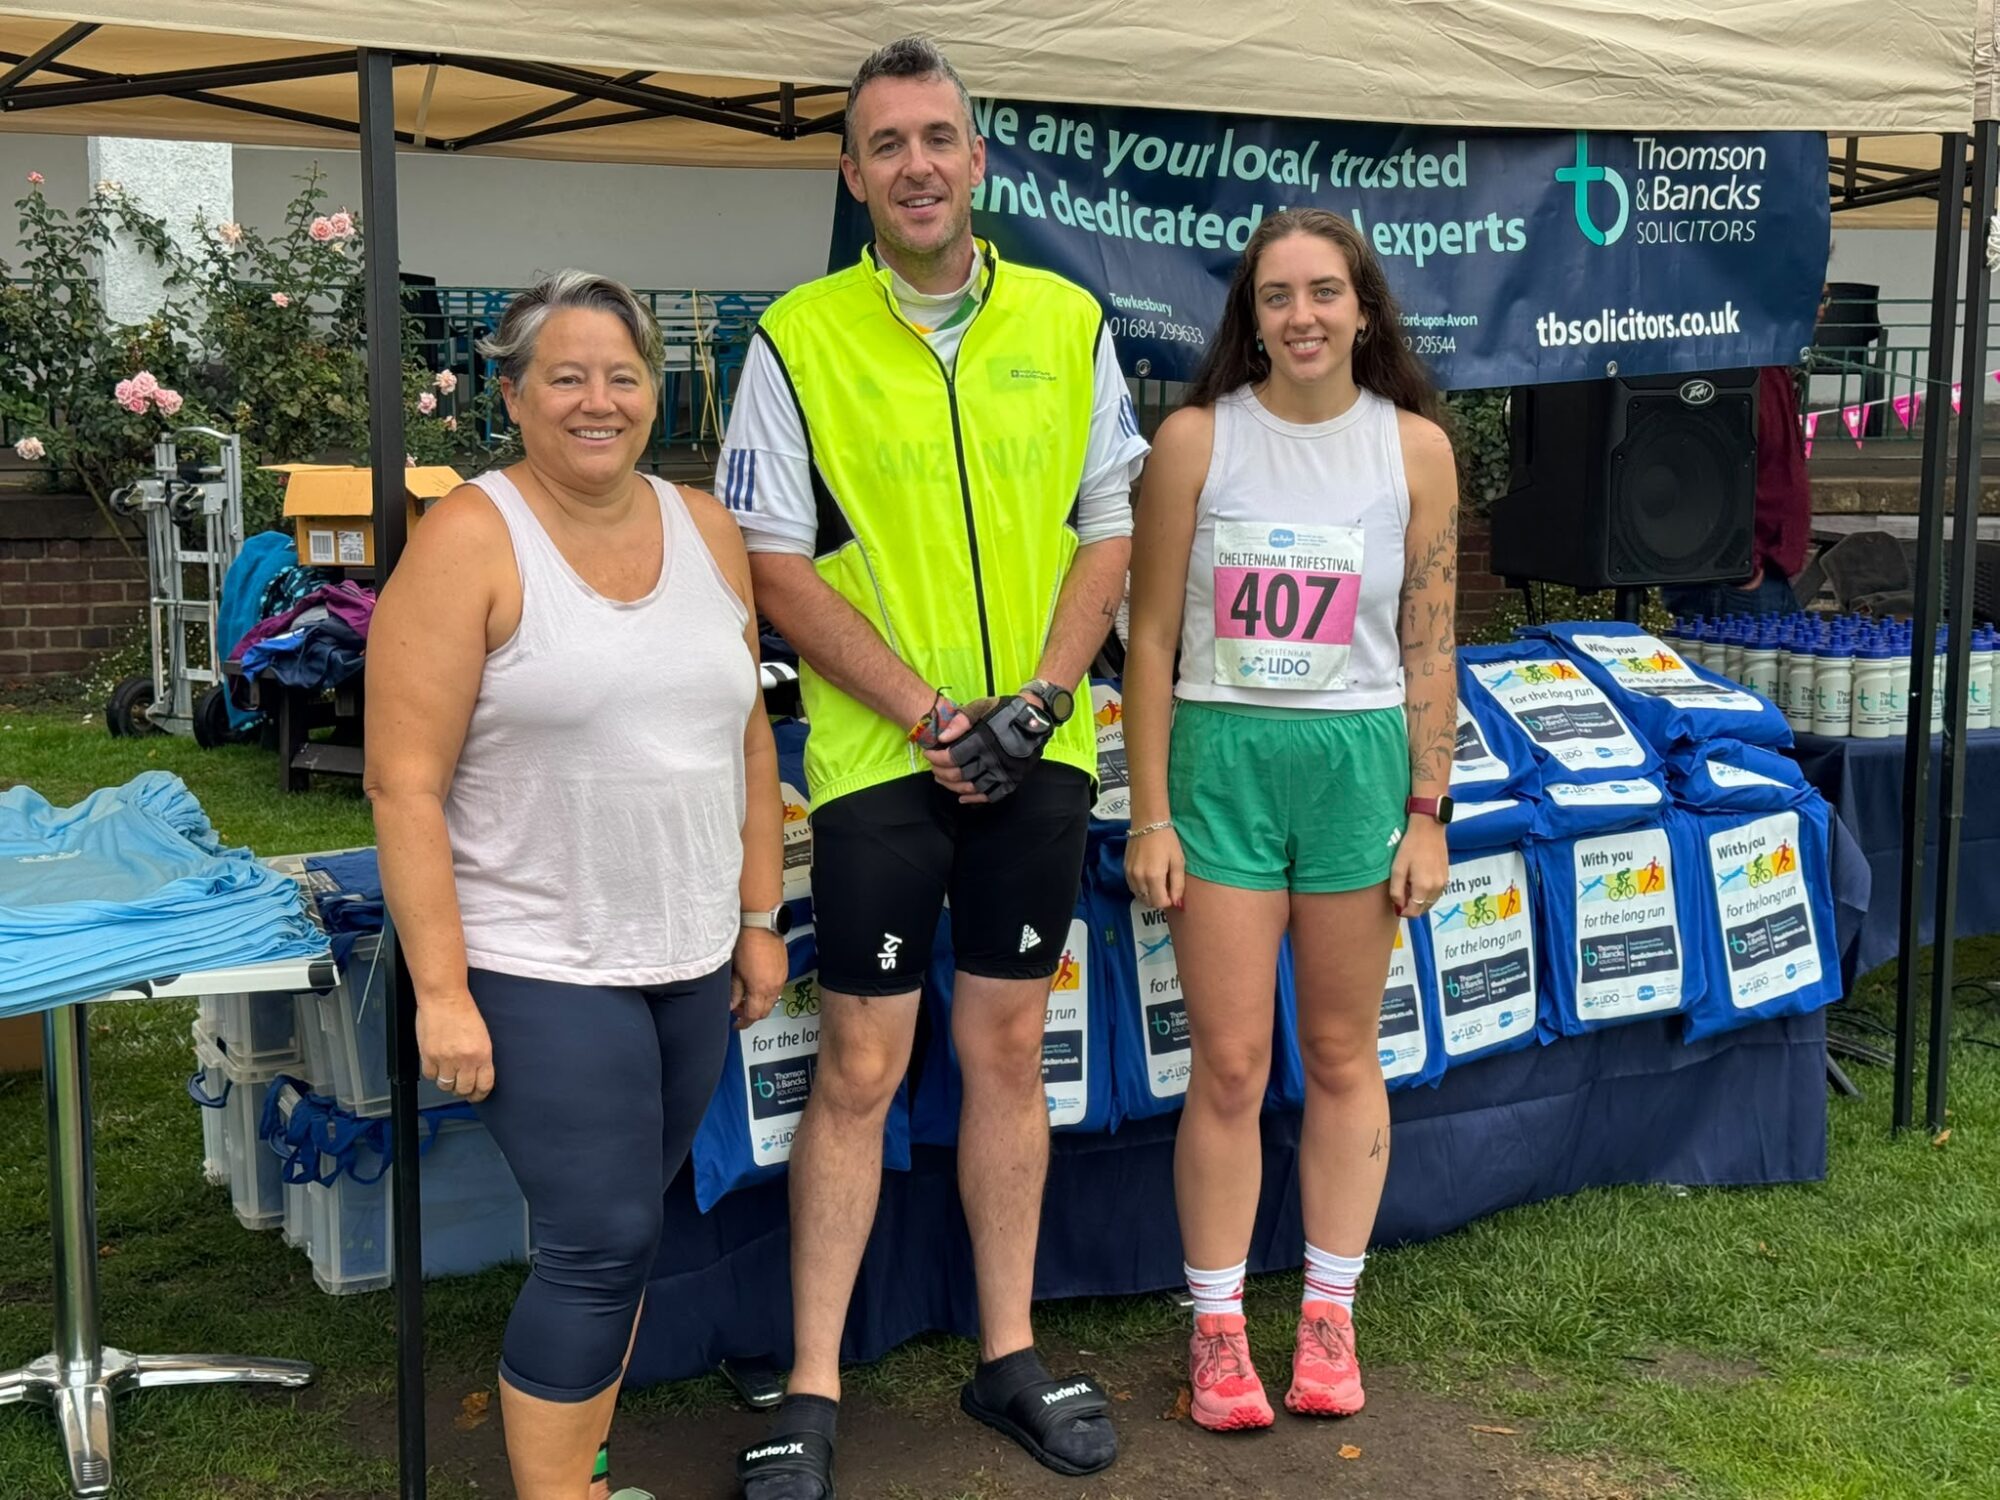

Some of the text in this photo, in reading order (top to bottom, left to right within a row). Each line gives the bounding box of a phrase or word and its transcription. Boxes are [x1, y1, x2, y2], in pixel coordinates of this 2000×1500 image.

[1028, 114, 1095, 161] are
[1103, 129, 1215, 178] your
[1218, 128, 1320, 193] local,
[1330, 140, 1467, 188] trusted
[1633, 137, 1766, 171] Thomson
[1050, 179, 1264, 252] dedicated
[1373, 212, 1527, 268] experts
[1637, 219, 1757, 244] SOLICITORS
[1108, 292, 1172, 317] Tewkesbury
[1110, 316, 1205, 345] 01684 299633
[1536, 302, 1740, 347] tbsolicitors.co.uk
[1416, 335, 1457, 354] 295544
[1219, 552, 1357, 572] CHELTENHAM TRIFESTIVAL
[1230, 572, 1341, 640] 407
[1258, 648, 1312, 658] CHELTENHAM
[1267, 657, 1310, 676] LIDO
[1509, 686, 1594, 706] for the long run
[1097, 731, 1123, 745] ong
[1581, 850, 1634, 867] With you
[1717, 842, 1748, 860] With
[1468, 874, 1492, 893] you
[1726, 903, 1745, 918] for
[1781, 885, 1797, 898] run
[1141, 910, 1167, 927] Wit
[1584, 906, 1665, 929] for the long run
[877, 932, 903, 970] sky
[1444, 929, 1522, 960] for the long run
[1387, 965, 1404, 978] un
[1150, 979, 1168, 993] for
[1600, 992, 1620, 1004] LIDO
[1055, 1007, 1077, 1020] run
[752, 1027, 820, 1053] for the lon
[778, 1131, 795, 1144] LID
[1041, 1384, 1080, 1406] Hurley
[746, 1445, 788, 1461] Hurley
